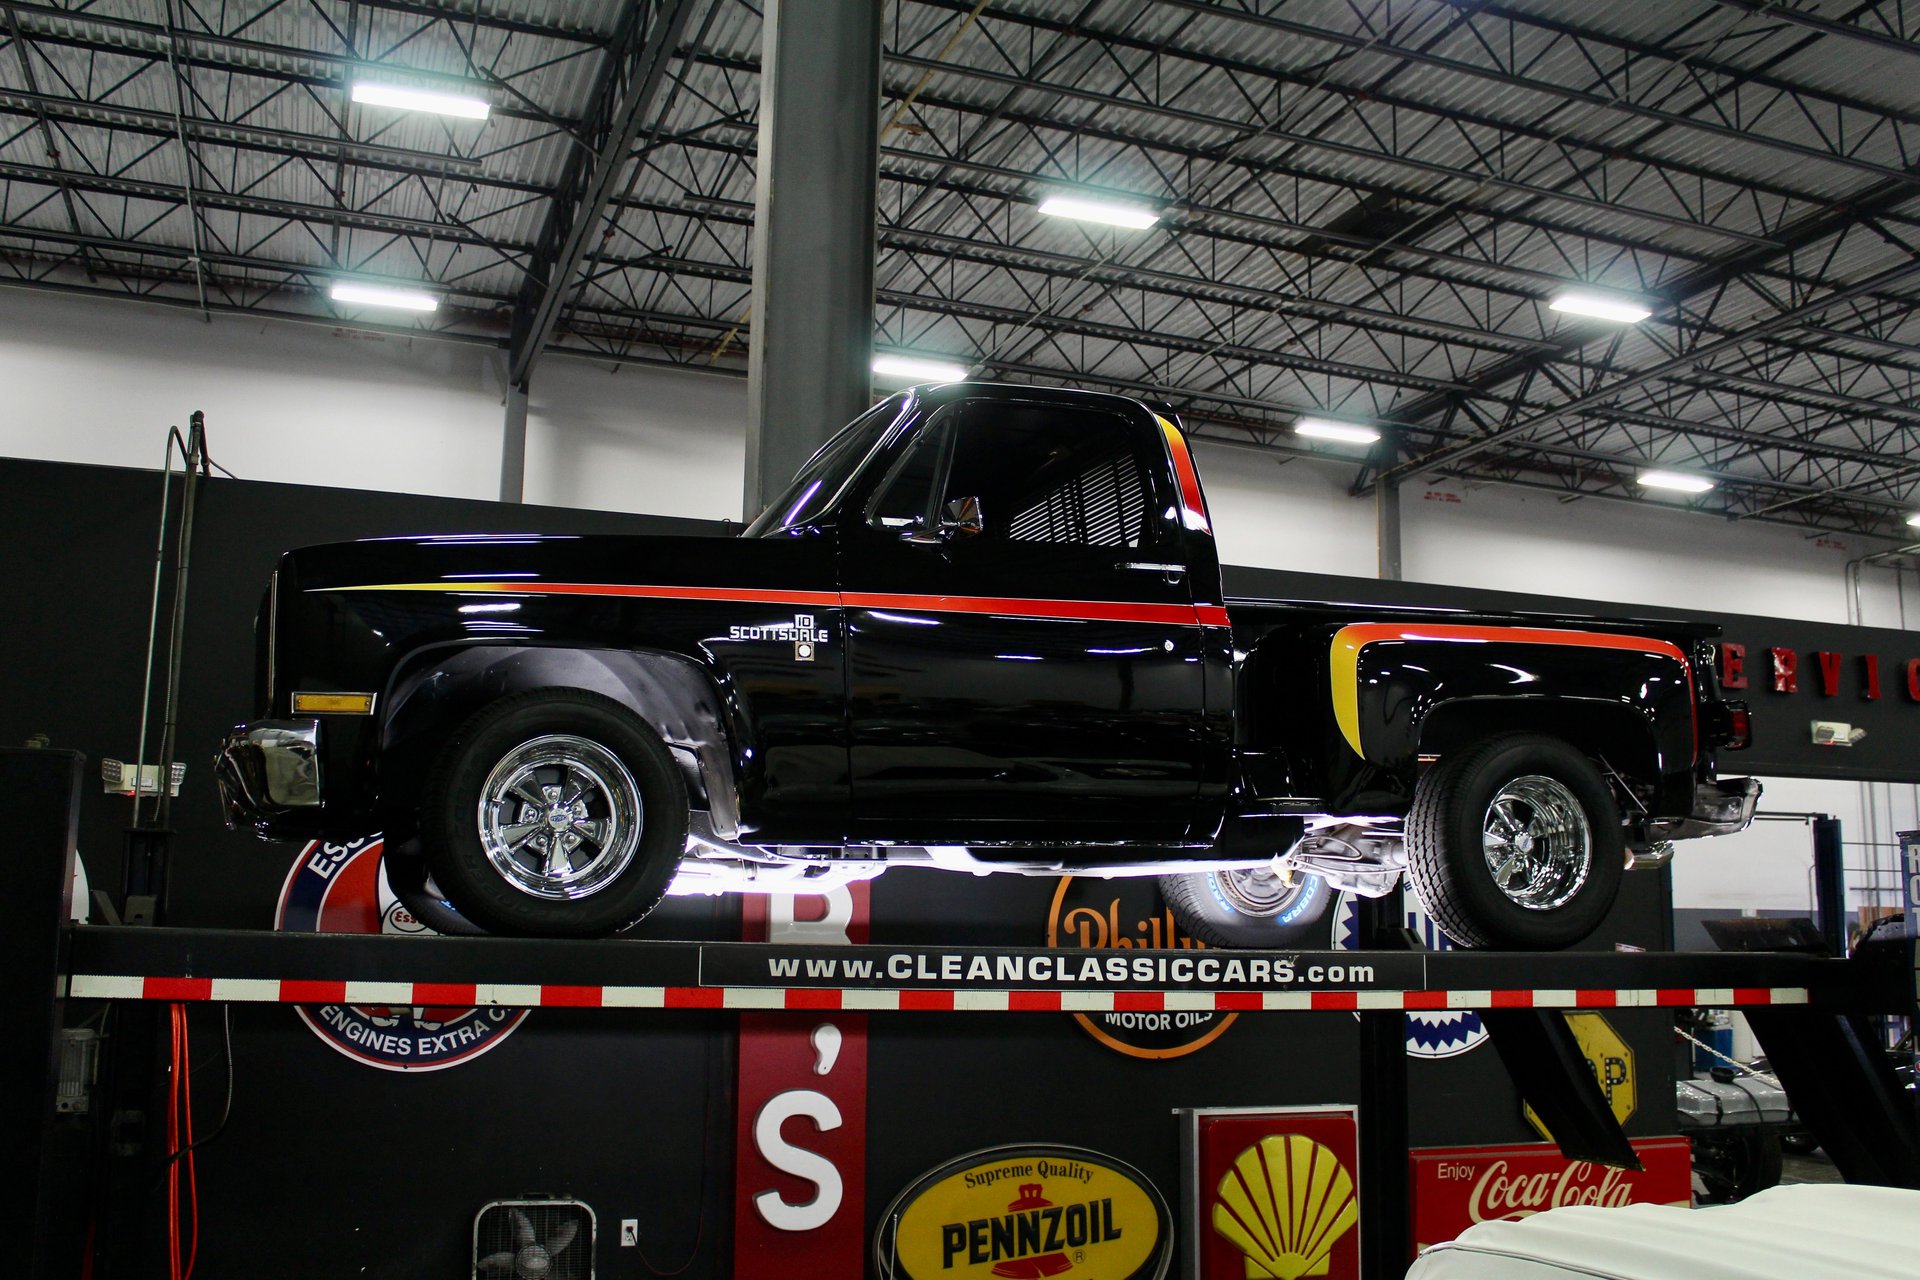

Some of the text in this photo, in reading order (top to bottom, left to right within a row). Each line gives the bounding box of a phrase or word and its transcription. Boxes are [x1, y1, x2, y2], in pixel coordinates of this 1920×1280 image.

[729, 626, 828, 642] SCOTTSDALE
[1281, 875, 1318, 922] COBRA
[394, 911, 417, 924] Ess
[768, 953, 1375, 985] www.CLEANCLASSICCARS.com
[320, 1005, 411, 1055] ENGINES
[418, 1019, 491, 1055] EXTRA
[1105, 1012, 1172, 1031] MOTOR
[964, 1160, 1094, 1189] Supreme Quality
[1437, 1154, 1636, 1224] Enjoy Coca-Cola
[942, 1197, 1122, 1269] PENNZOIL
